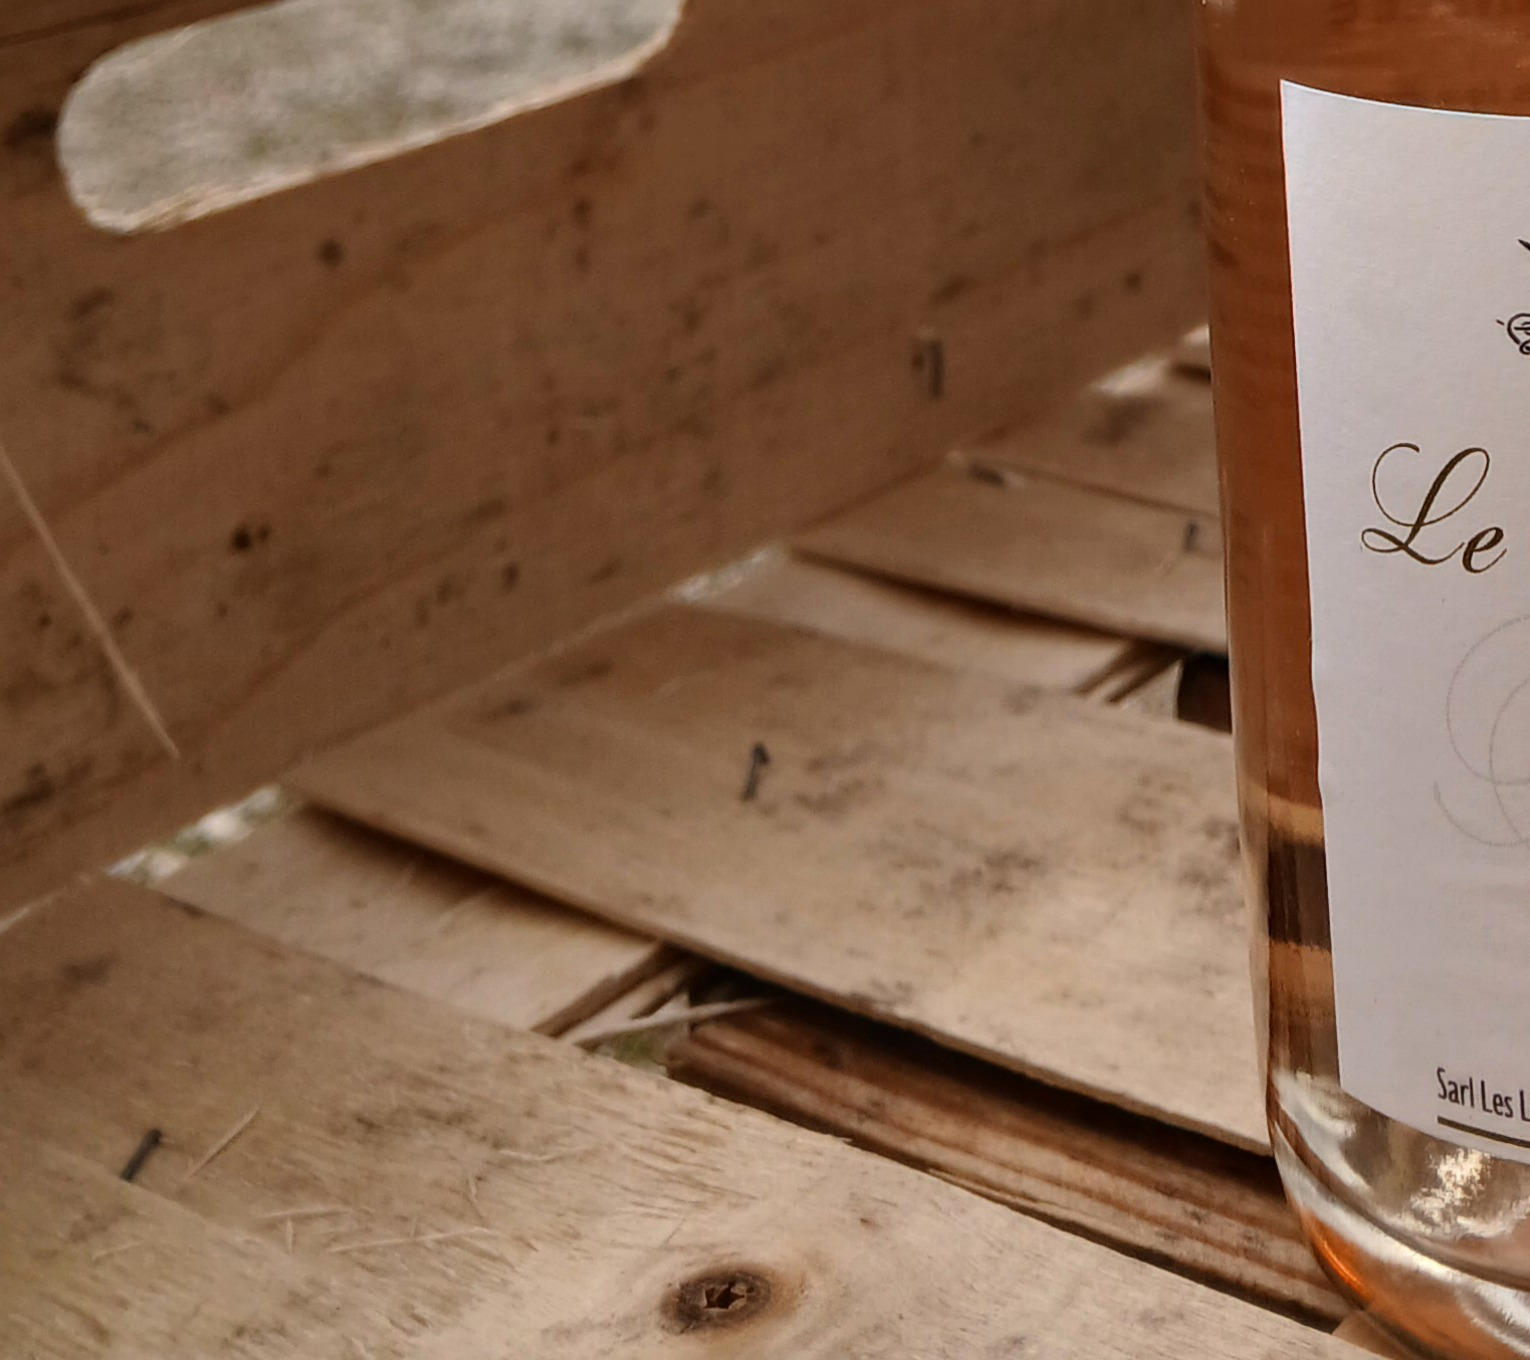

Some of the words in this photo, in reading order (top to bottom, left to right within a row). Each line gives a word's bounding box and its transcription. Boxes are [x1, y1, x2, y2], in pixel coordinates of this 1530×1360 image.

[1361, 443, 1508, 574] Le
[1436, 1067, 1475, 1108] Sarl
[1481, 1080, 1514, 1118] Les
